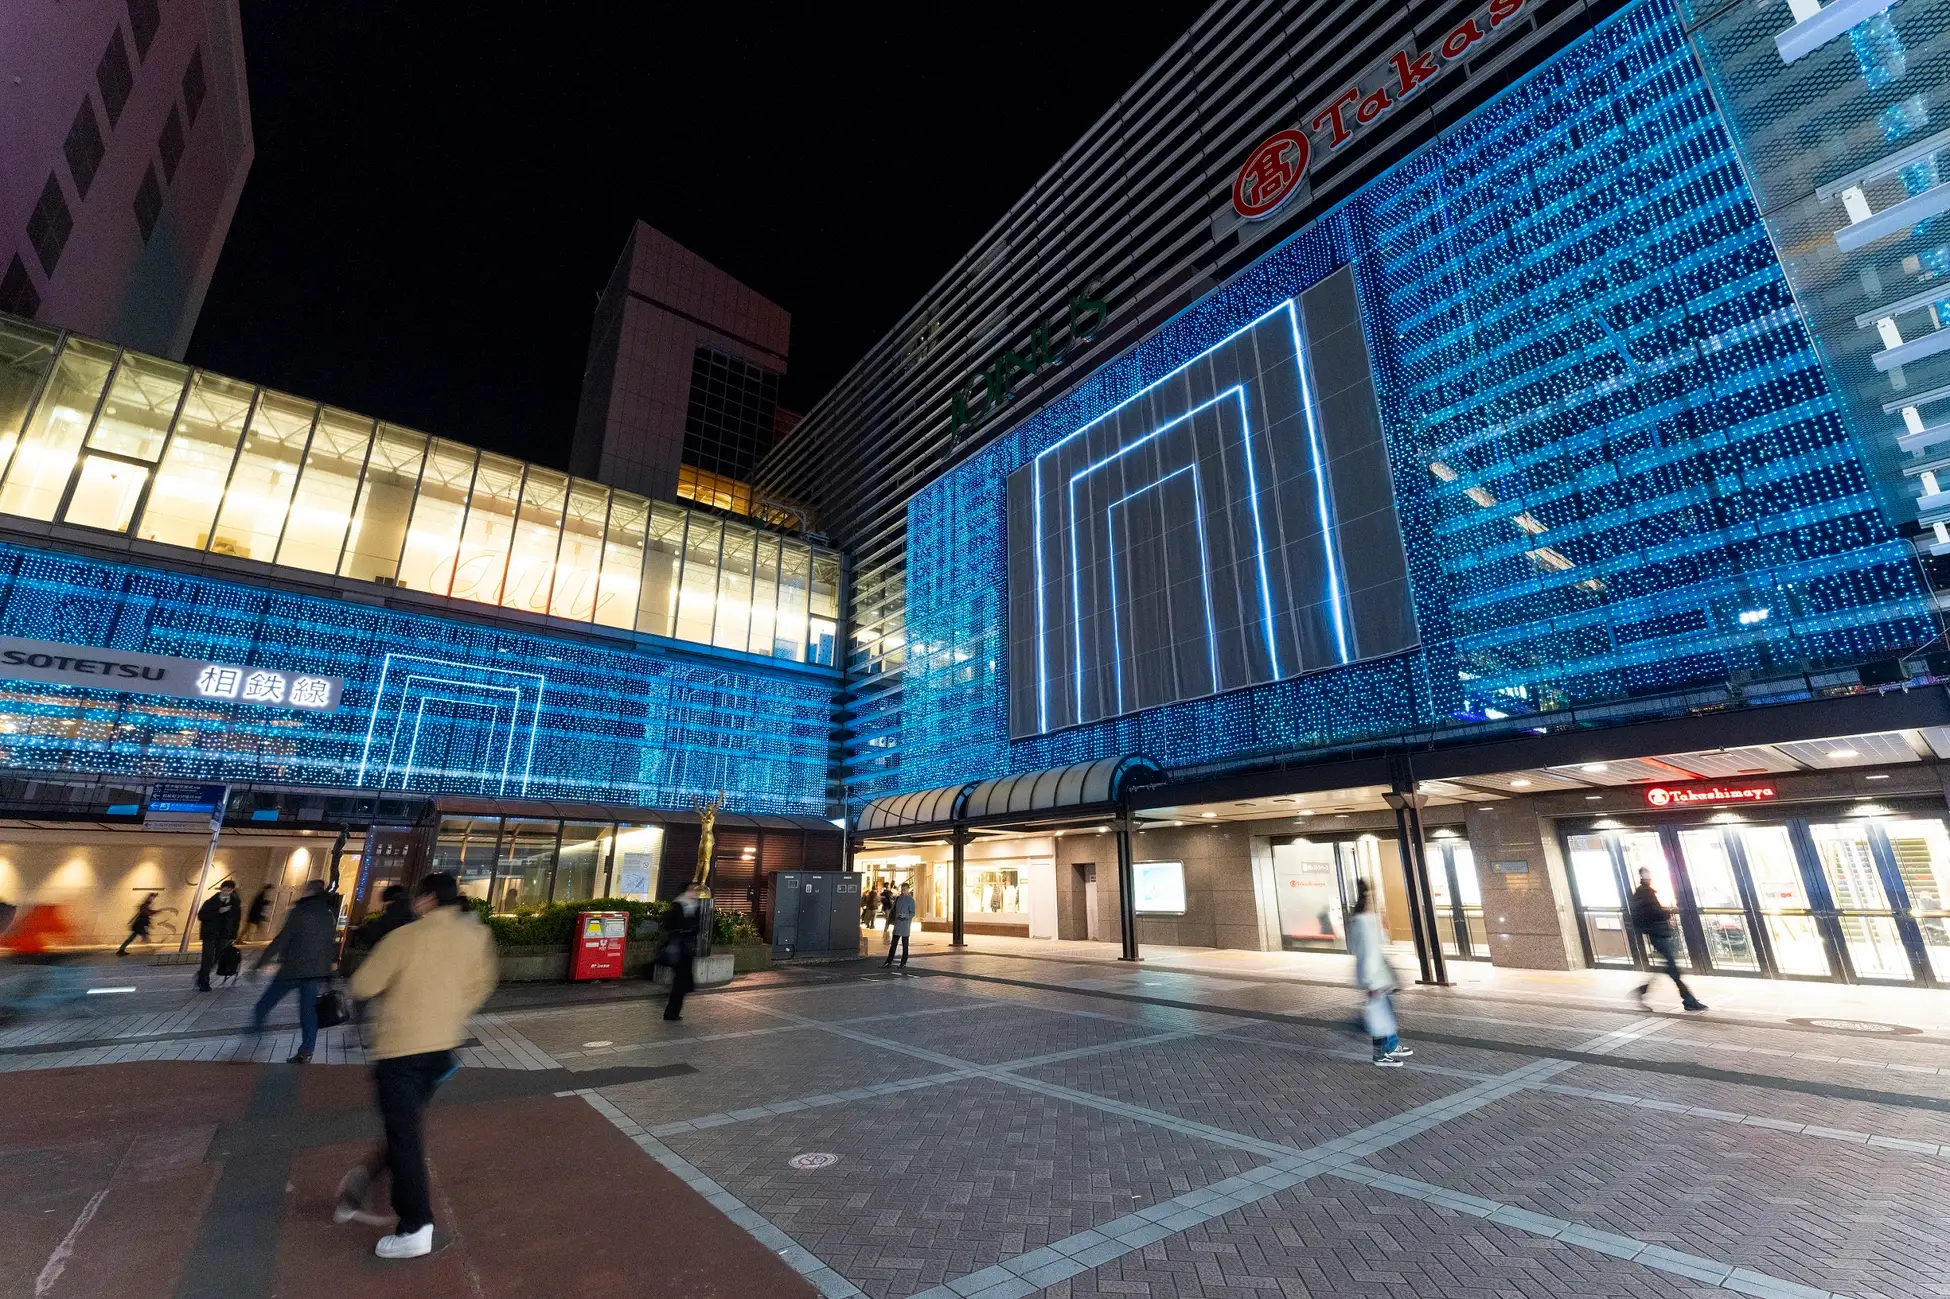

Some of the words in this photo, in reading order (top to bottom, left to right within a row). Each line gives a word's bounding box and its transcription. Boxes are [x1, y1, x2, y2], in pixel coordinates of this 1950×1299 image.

[943, 276, 1108, 460] JOINUS
[1, 650, 166, 681] SOTETSU
[199, 666, 329, 704] 相鉄線
[1669, 787, 1774, 802] Takashimaya
